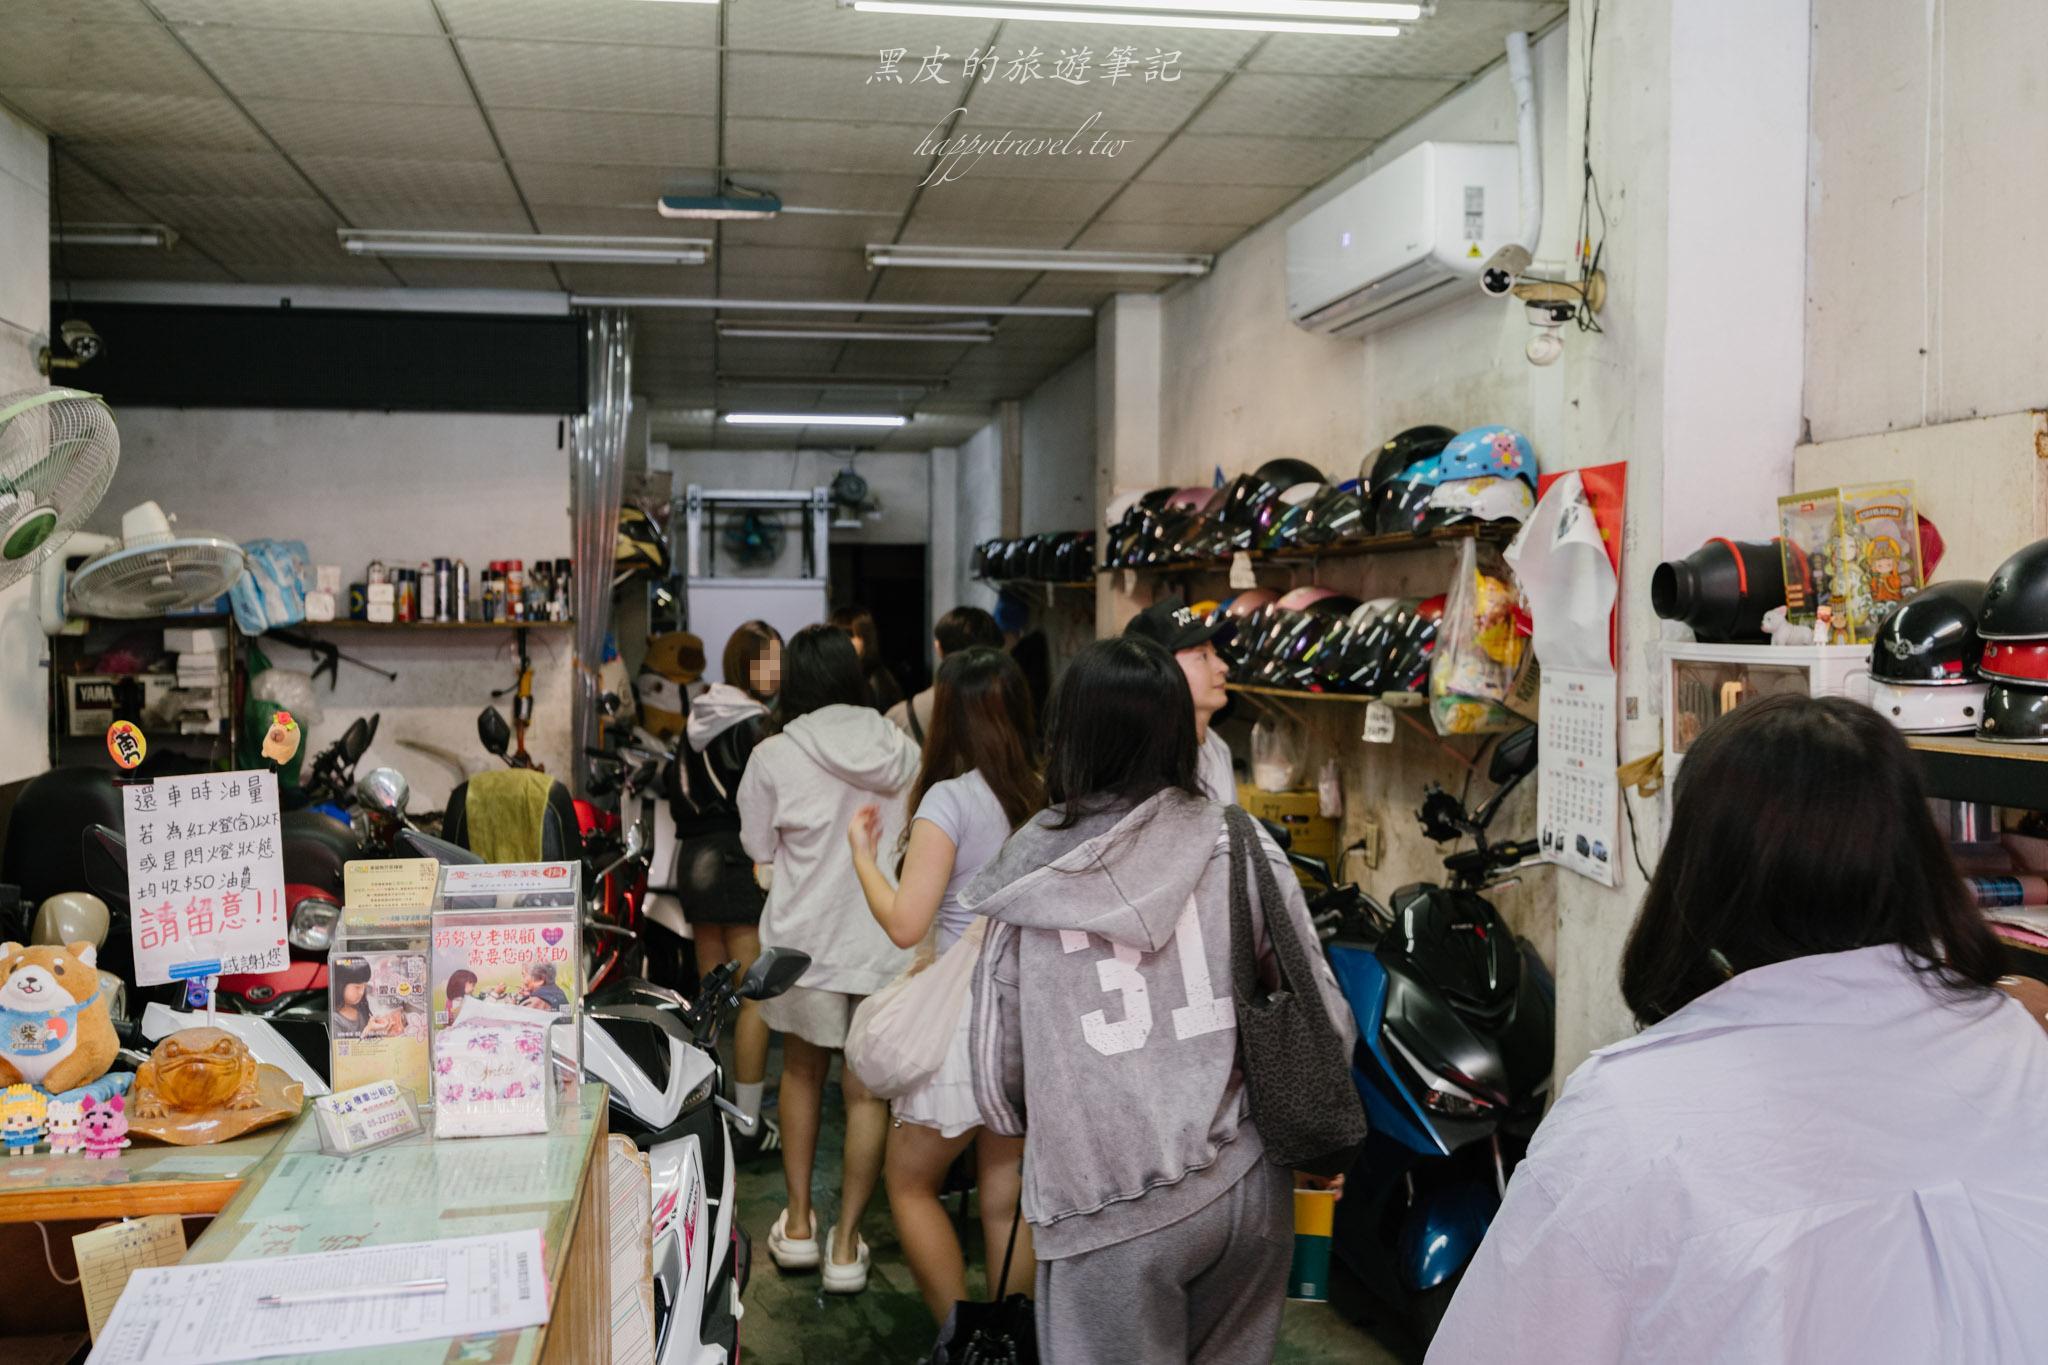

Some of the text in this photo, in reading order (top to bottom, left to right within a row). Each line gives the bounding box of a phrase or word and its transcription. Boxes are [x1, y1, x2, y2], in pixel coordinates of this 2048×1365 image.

[80, 685, 118, 701] YAMA
[134, 775, 263, 812] 還車時油量
[139, 837, 275, 874] 或是閃燈狀態
[434, 927, 536, 949] 弱勢兒老照顧
[467, 946, 568, 967] 需要您的幫助
